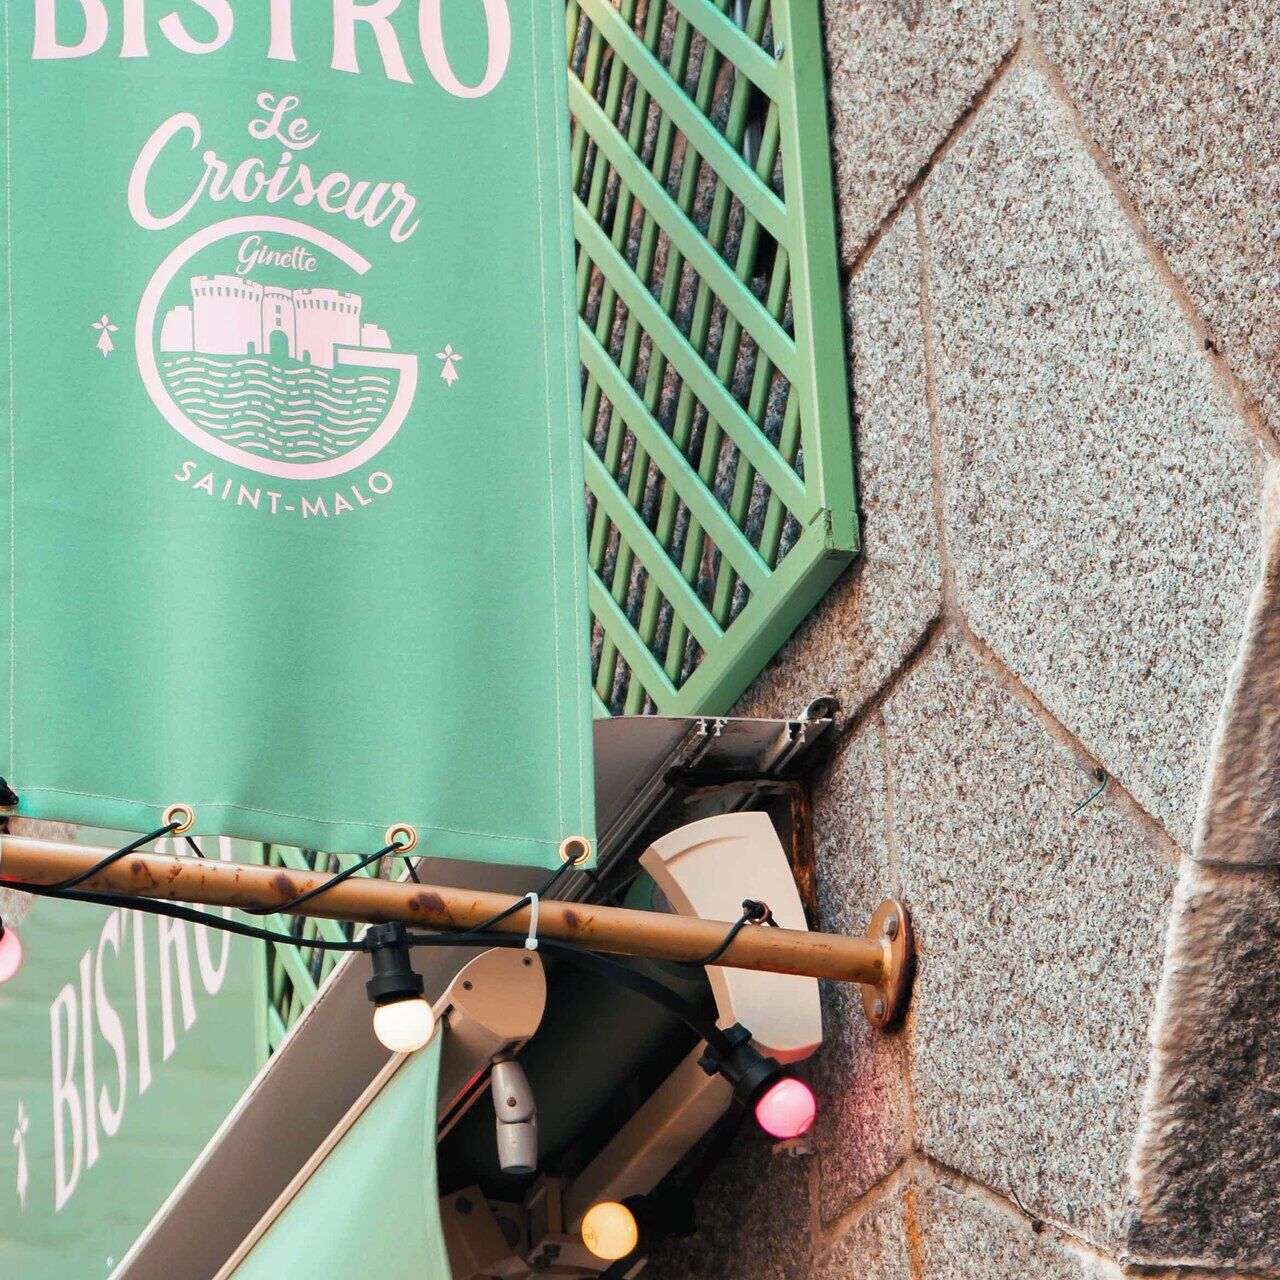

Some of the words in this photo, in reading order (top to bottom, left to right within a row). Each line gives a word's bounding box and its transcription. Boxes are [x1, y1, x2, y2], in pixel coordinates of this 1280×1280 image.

[248, 92, 321, 150] Le
[127, 112, 420, 243] Croiseur
[235, 235, 319, 275] Ginette
[174, 460, 394, 519] SAINT-MALO
